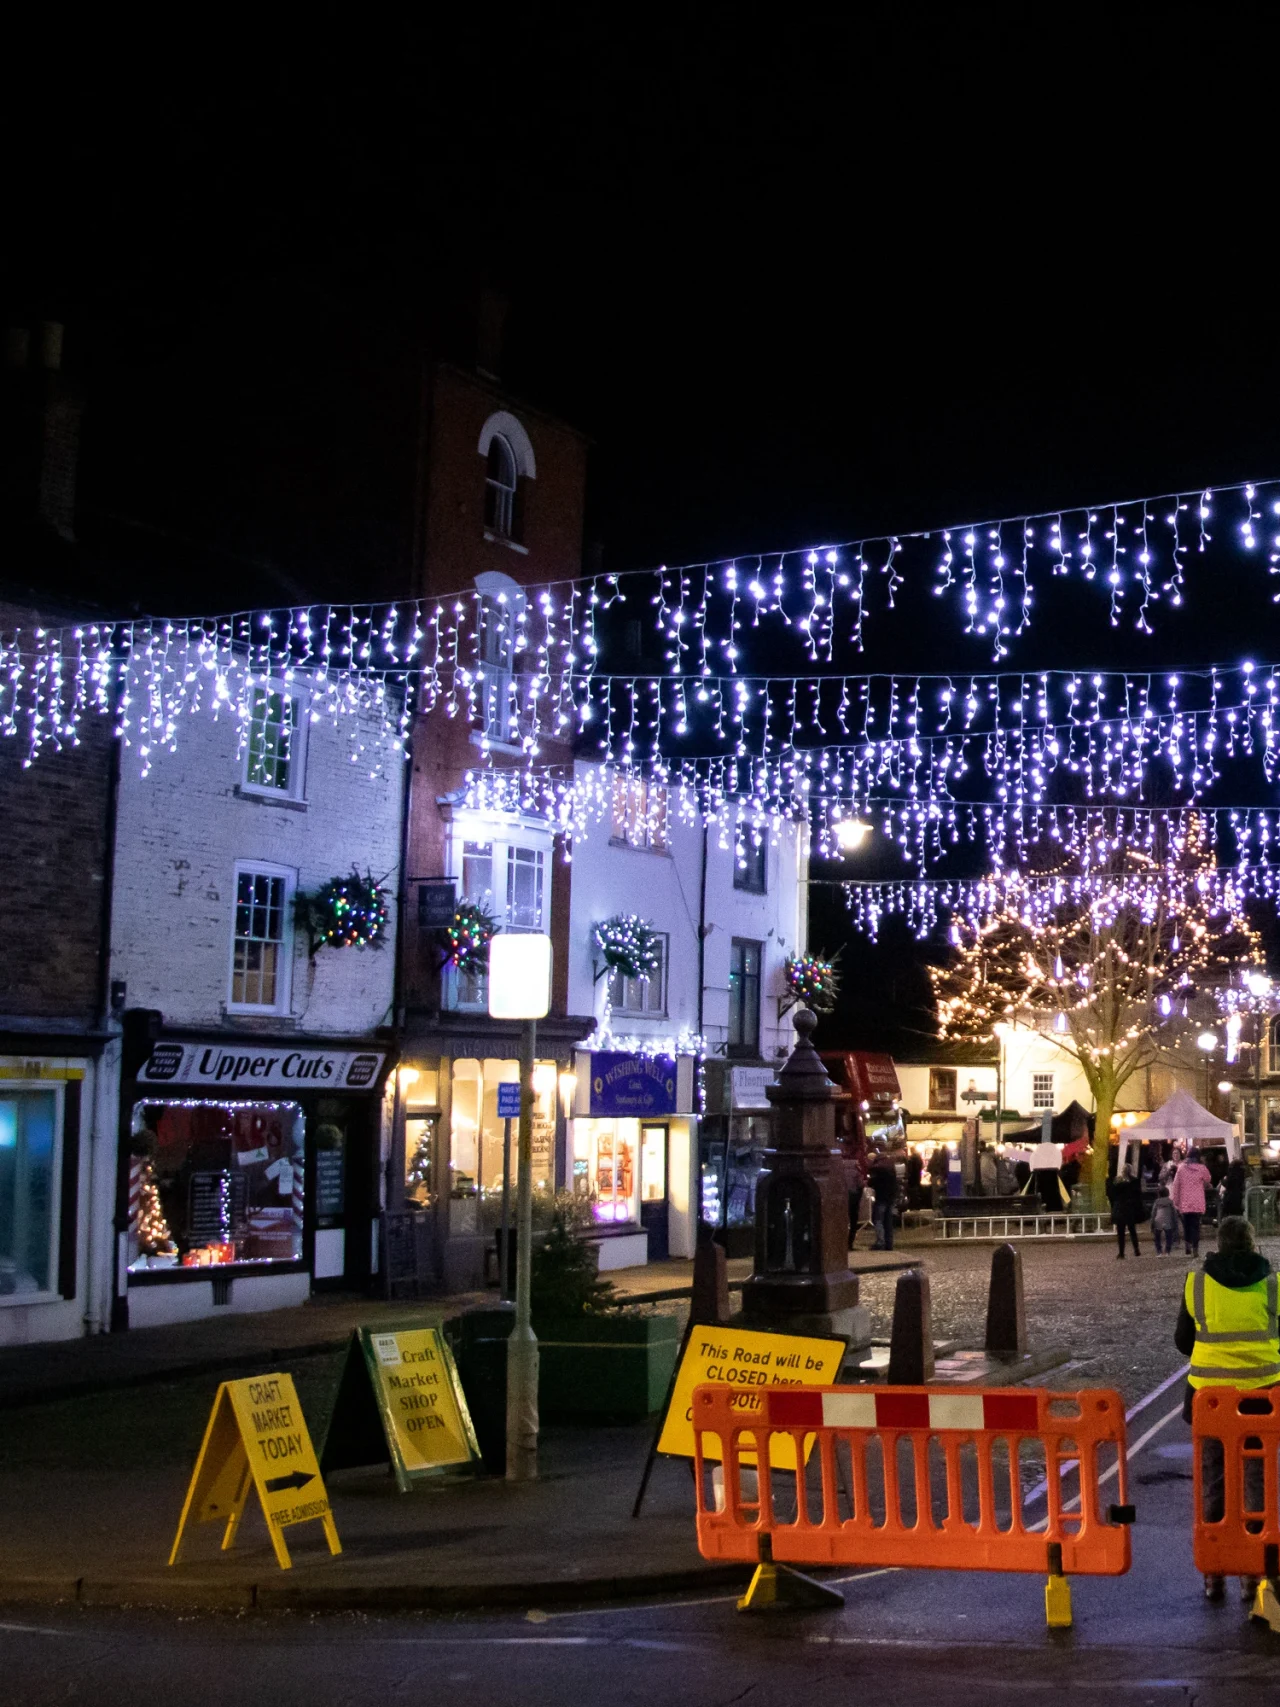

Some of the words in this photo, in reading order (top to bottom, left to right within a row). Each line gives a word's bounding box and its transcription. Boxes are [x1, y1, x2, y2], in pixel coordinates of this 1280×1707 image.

[199, 1048, 280, 1081] Upper
[281, 1053, 335, 1079] Cuts
[604, 1059, 644, 1085] WISHING
[644, 1059, 665, 1085] WELL
[402, 1348, 436, 1364] Craft
[700, 1342, 728, 1360] This
[733, 1347, 772, 1366] Road
[775, 1354, 801, 1369] will
[805, 1355, 824, 1371] be
[388, 1372, 440, 1390] Market
[706, 1365, 768, 1386] CLOSED
[249, 1380, 282, 1405] CRAFT
[400, 1393, 438, 1411] SHOP
[251, 1405, 294, 1433] MARKET
[406, 1415, 446, 1432] OPEN
[258, 1433, 303, 1461] TODAY
[270, 1510, 292, 1528] FREE
[291, 1499, 329, 1523] ADMISSION
